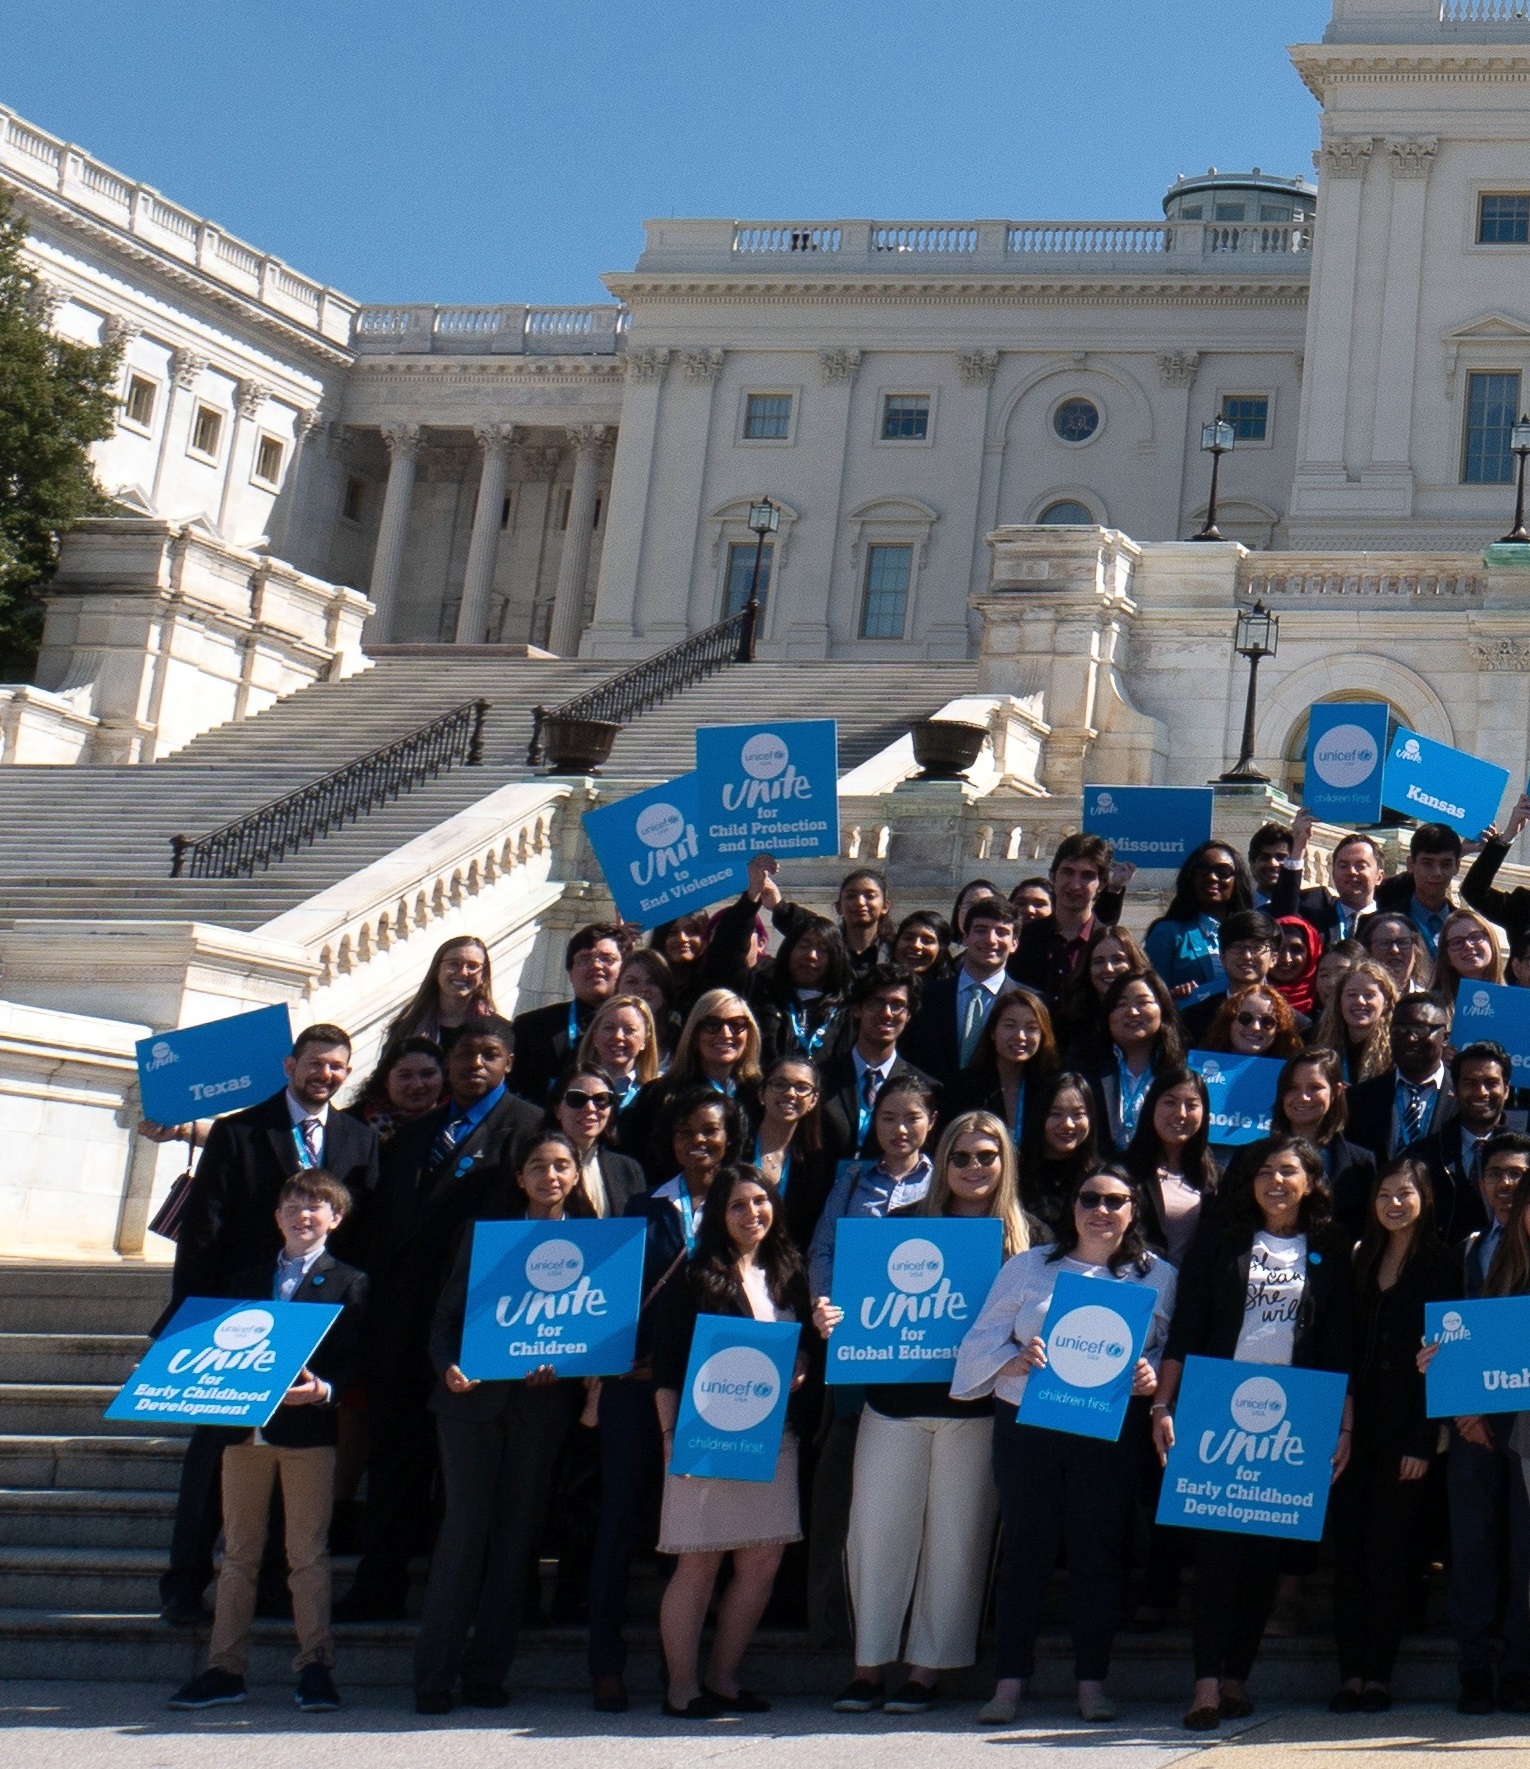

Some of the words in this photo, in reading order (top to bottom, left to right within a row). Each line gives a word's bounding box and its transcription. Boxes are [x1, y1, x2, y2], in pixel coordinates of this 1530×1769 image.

[1318, 750, 1357, 762] unicef
[1406, 784, 1466, 819] Kansas
[758, 807, 778, 818] for
[709, 824, 748, 838] Child
[752, 820, 828, 836] Protection
[718, 838, 746, 852] and
[750, 835, 819, 850] Inclusion
[1108, 837, 1184, 852] Missouri
[674, 868, 690, 882] to
[640, 895, 669, 912] End
[670, 866, 734, 899] Violence
[189, 1075, 251, 1101] Texas
[892, 1259, 926, 1272] unicef
[1246, 1281, 1287, 1312] She
[536, 1324, 564, 1337] for
[900, 1326, 926, 1342] for
[509, 1341, 588, 1356] Children
[837, 1344, 894, 1361] Global
[898, 1344, 958, 1360] Educat
[1055, 1334, 1106, 1354] unicef
[197, 1374, 224, 1385] for
[701, 1378, 752, 1396] unicef
[133, 1384, 181, 1400] Early
[182, 1387, 272, 1402] Childhood
[1038, 1388, 1086, 1407] children
[135, 1399, 250, 1416] Development
[1235, 1397, 1269, 1410] unicef
[688, 1436, 736, 1451] children
[1235, 1464, 1262, 1482] for
[1176, 1478, 1222, 1500] Early
[1226, 1483, 1314, 1508] Childhood
[1184, 1498, 1300, 1525] Development
